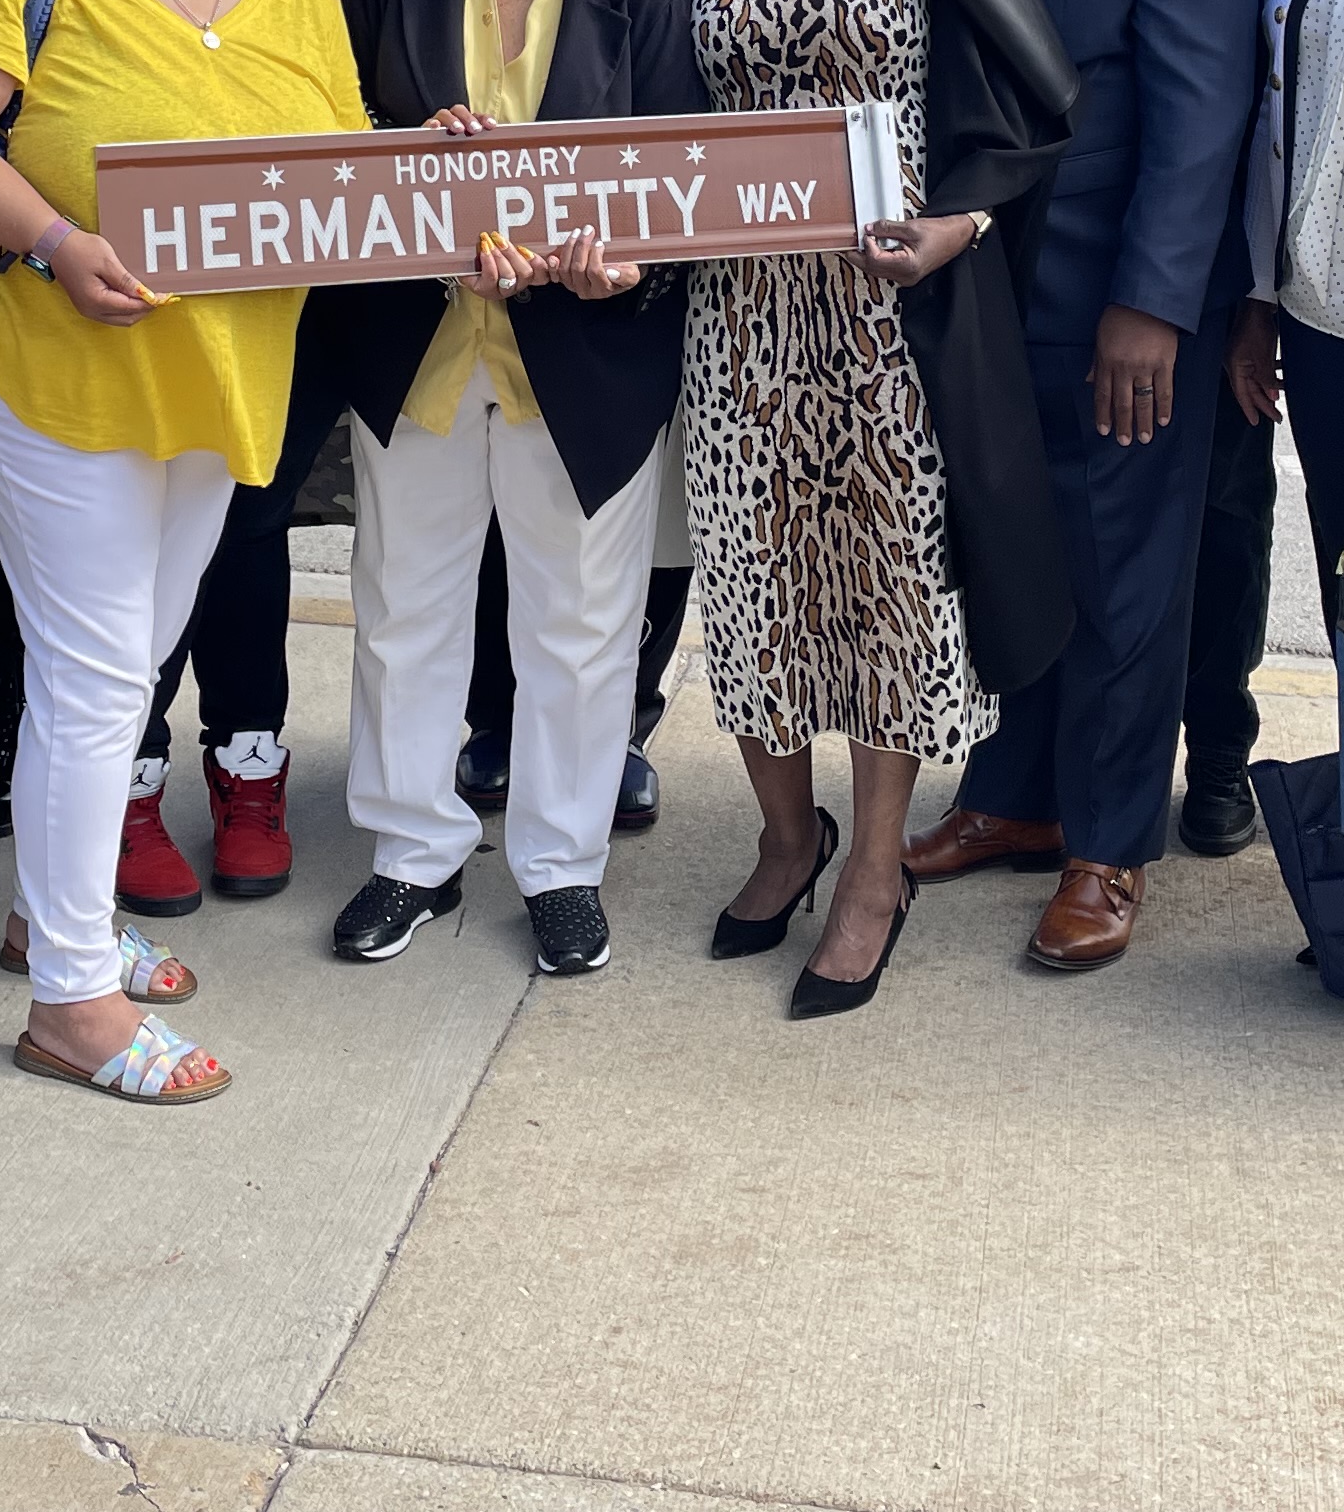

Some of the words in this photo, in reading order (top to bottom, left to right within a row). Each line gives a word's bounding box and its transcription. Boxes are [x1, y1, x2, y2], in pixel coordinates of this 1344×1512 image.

[394, 144, 582, 185] HONORARY
[142, 189, 457, 274] HERMAN
[495, 174, 706, 246] PETTY
[736, 180, 818, 224] WAY
